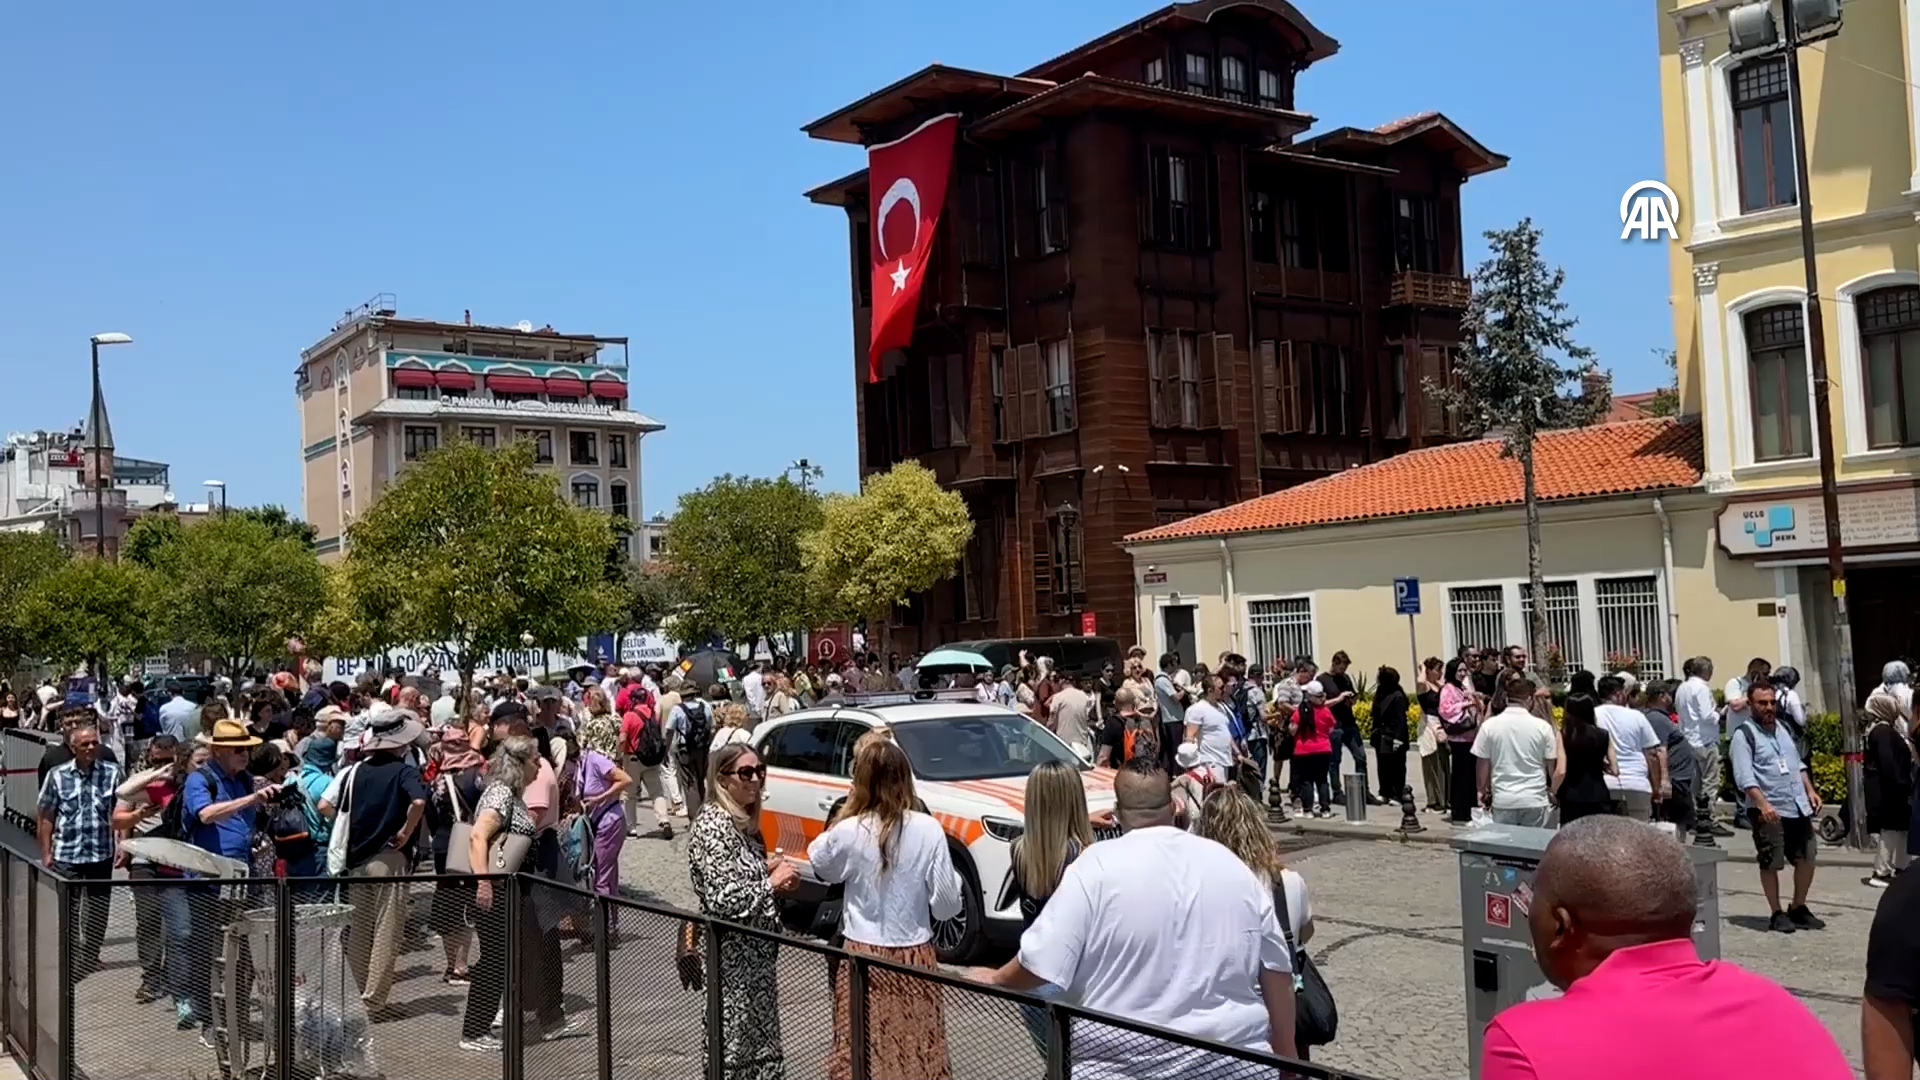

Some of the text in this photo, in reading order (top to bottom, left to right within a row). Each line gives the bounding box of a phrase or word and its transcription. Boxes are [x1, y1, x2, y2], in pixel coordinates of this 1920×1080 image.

[452, 396, 613, 416] PANORAMA RESTAURANT
[1395, 581, 1409, 608] P
[428, 650, 491, 672] YAKDA
